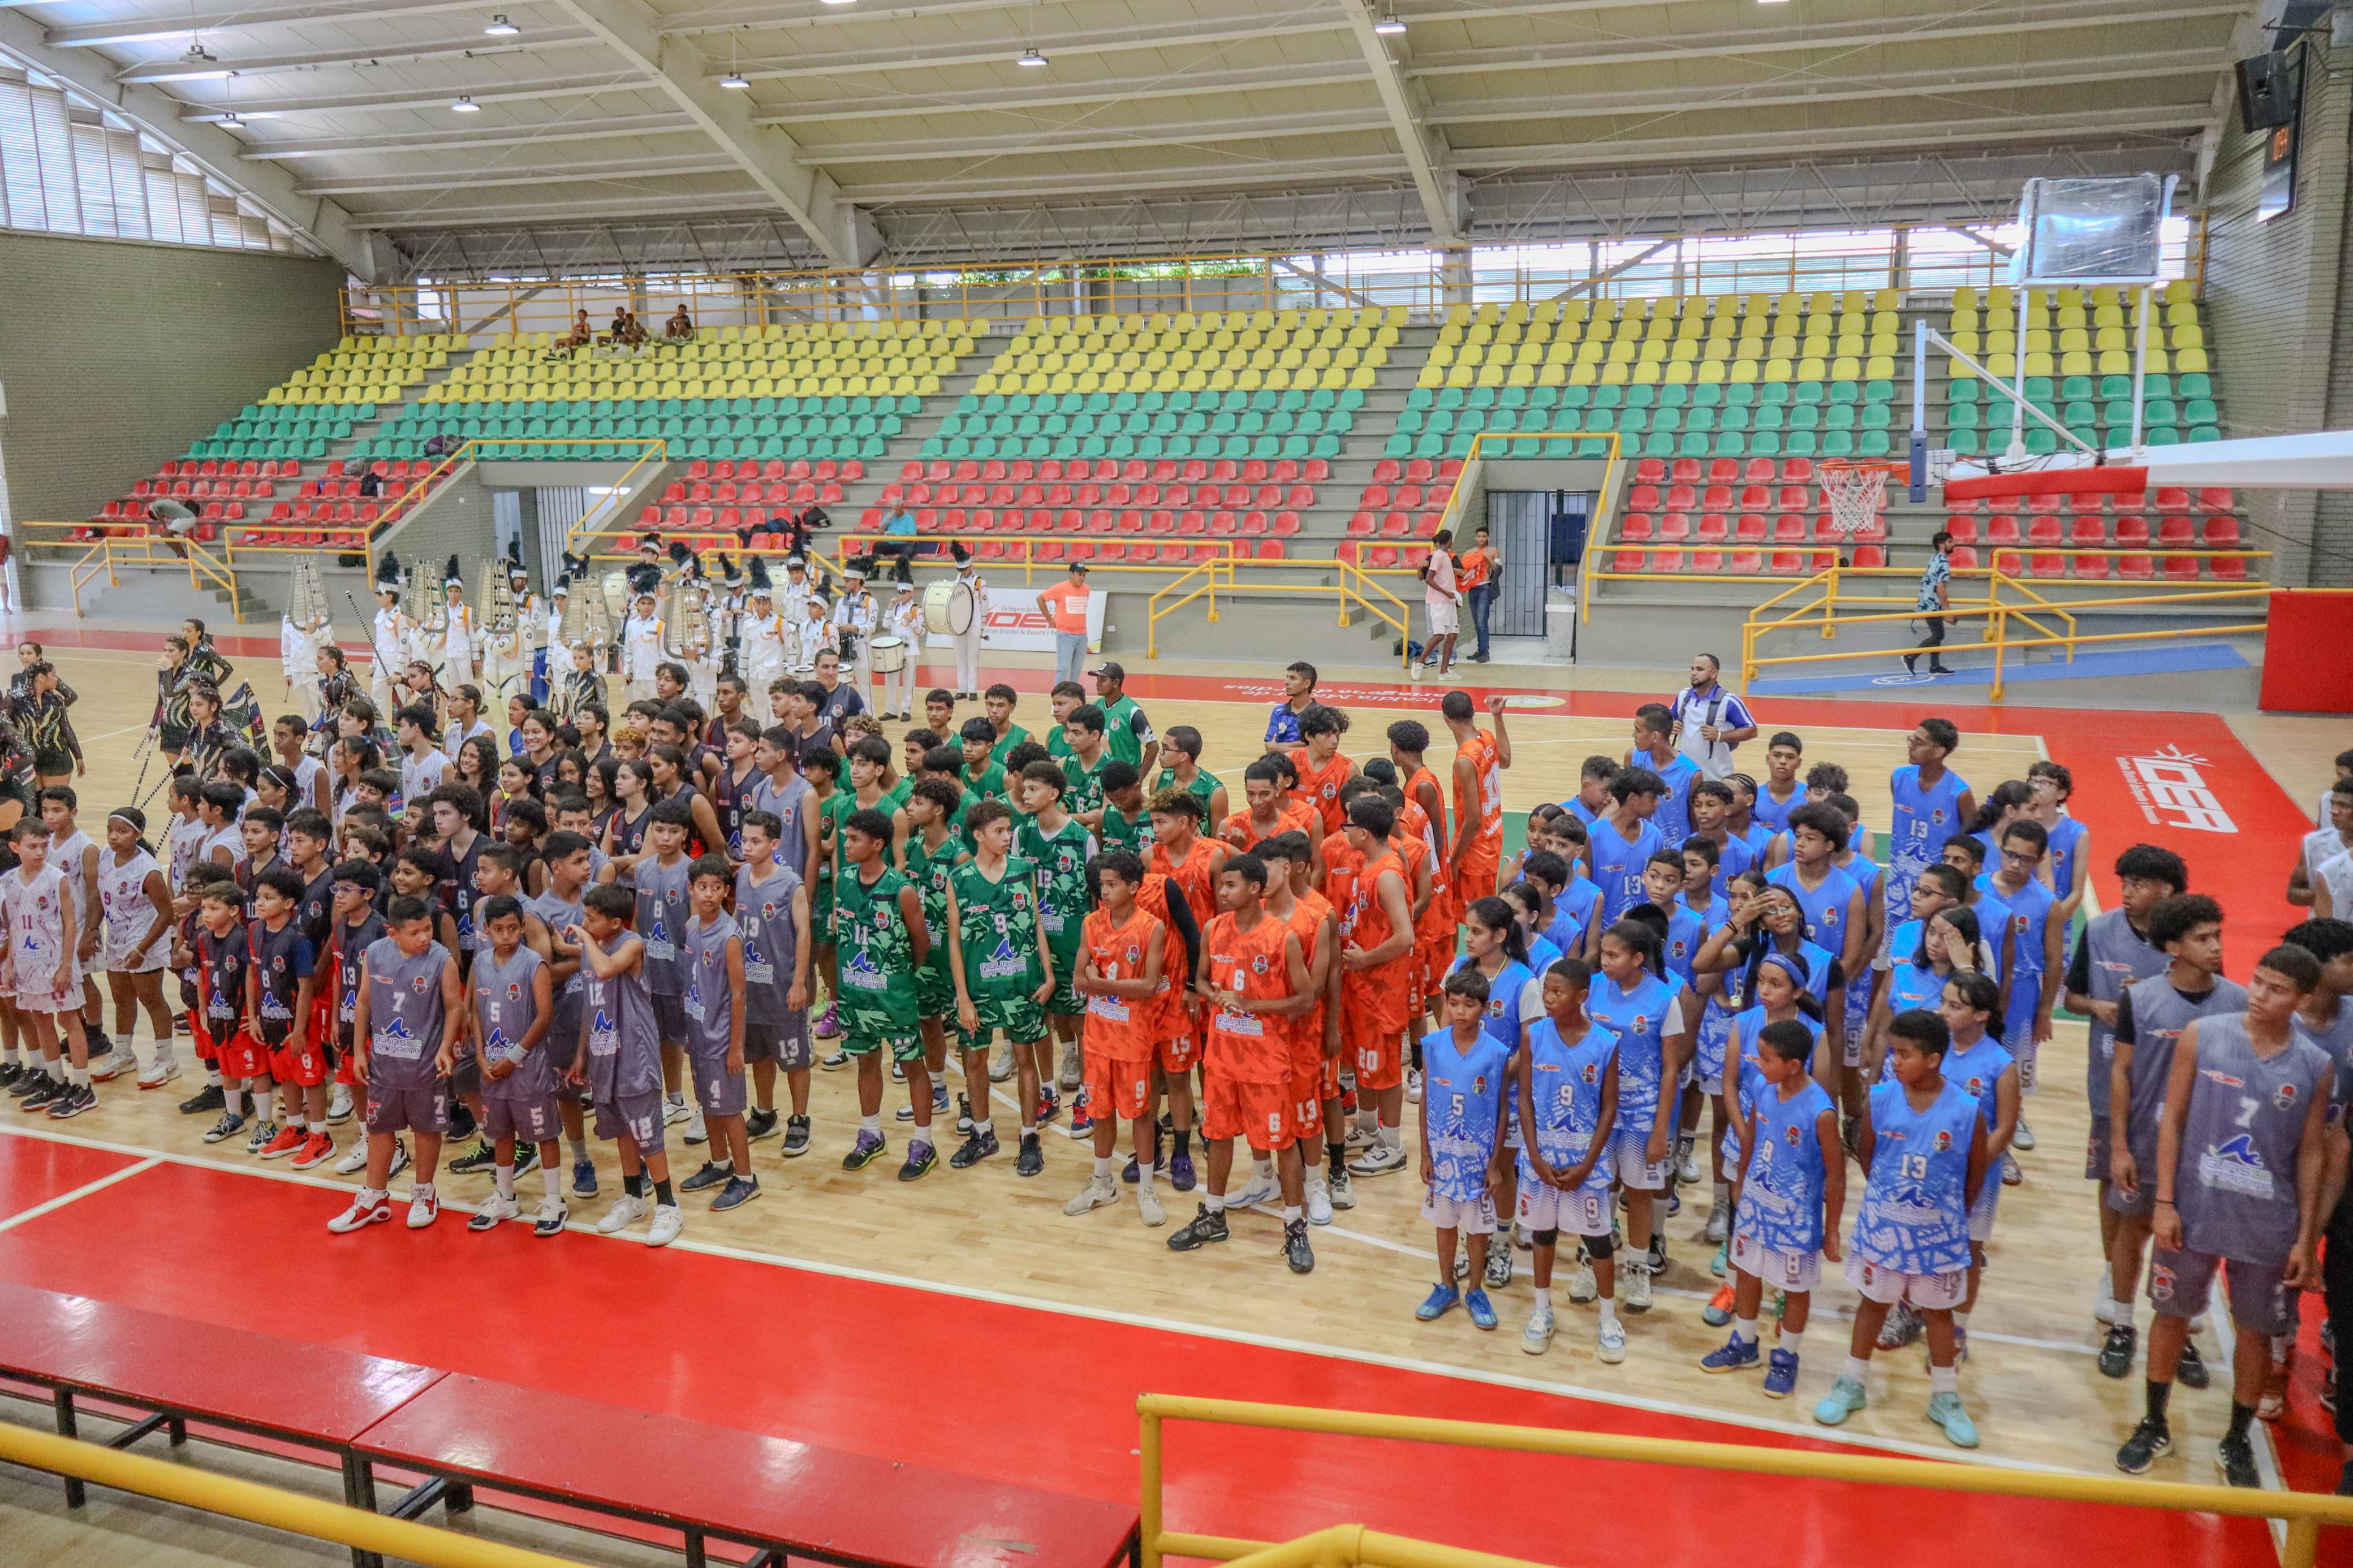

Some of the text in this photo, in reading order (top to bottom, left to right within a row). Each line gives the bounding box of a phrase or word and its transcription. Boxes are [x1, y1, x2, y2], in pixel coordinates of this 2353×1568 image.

[985, 612, 1056, 628] IDE
[2132, 758, 2239, 833] IDER
[1910, 818, 1928, 839] 13
[1037, 868, 1053, 889] 12
[1624, 875, 1641, 896] 13
[104, 891, 111, 905] 9
[458, 889, 467, 909] 6
[654, 900, 662, 919] 8
[22, 915, 32, 929] 11
[743, 915, 760, 938] 13
[994, 913, 1008, 934] 9
[855, 924, 869, 946] 11
[212, 971, 220, 987] 4
[262, 970, 270, 988] 8
[342, 966, 356, 986] 13
[1233, 969, 1246, 991] 6
[393, 992, 406, 1013] 7
[490, 1001, 501, 1023] 5
[778, 1036, 799, 1059] 13
[1171, 1036, 1190, 1055] 15
[709, 1079, 721, 1099] 4
[1135, 1079, 1145, 1099] 9
[1560, 1083, 1574, 1107] 9
[434, 1095, 445, 1115] 7
[1297, 1099, 1317, 1122] 13
[1452, 1094, 1465, 1116] 5
[2234, 1096, 2260, 1129] 7
[531, 1107, 544, 1126] 5
[1269, 1112, 1281, 1133] 6
[1761, 1139, 1774, 1163] 8
[1902, 1153, 1927, 1180] 13
[1480, 1192, 1492, 1213] 5
[1585, 1196, 1600, 1220] 9
[1785, 1252, 1802, 1276] 8
